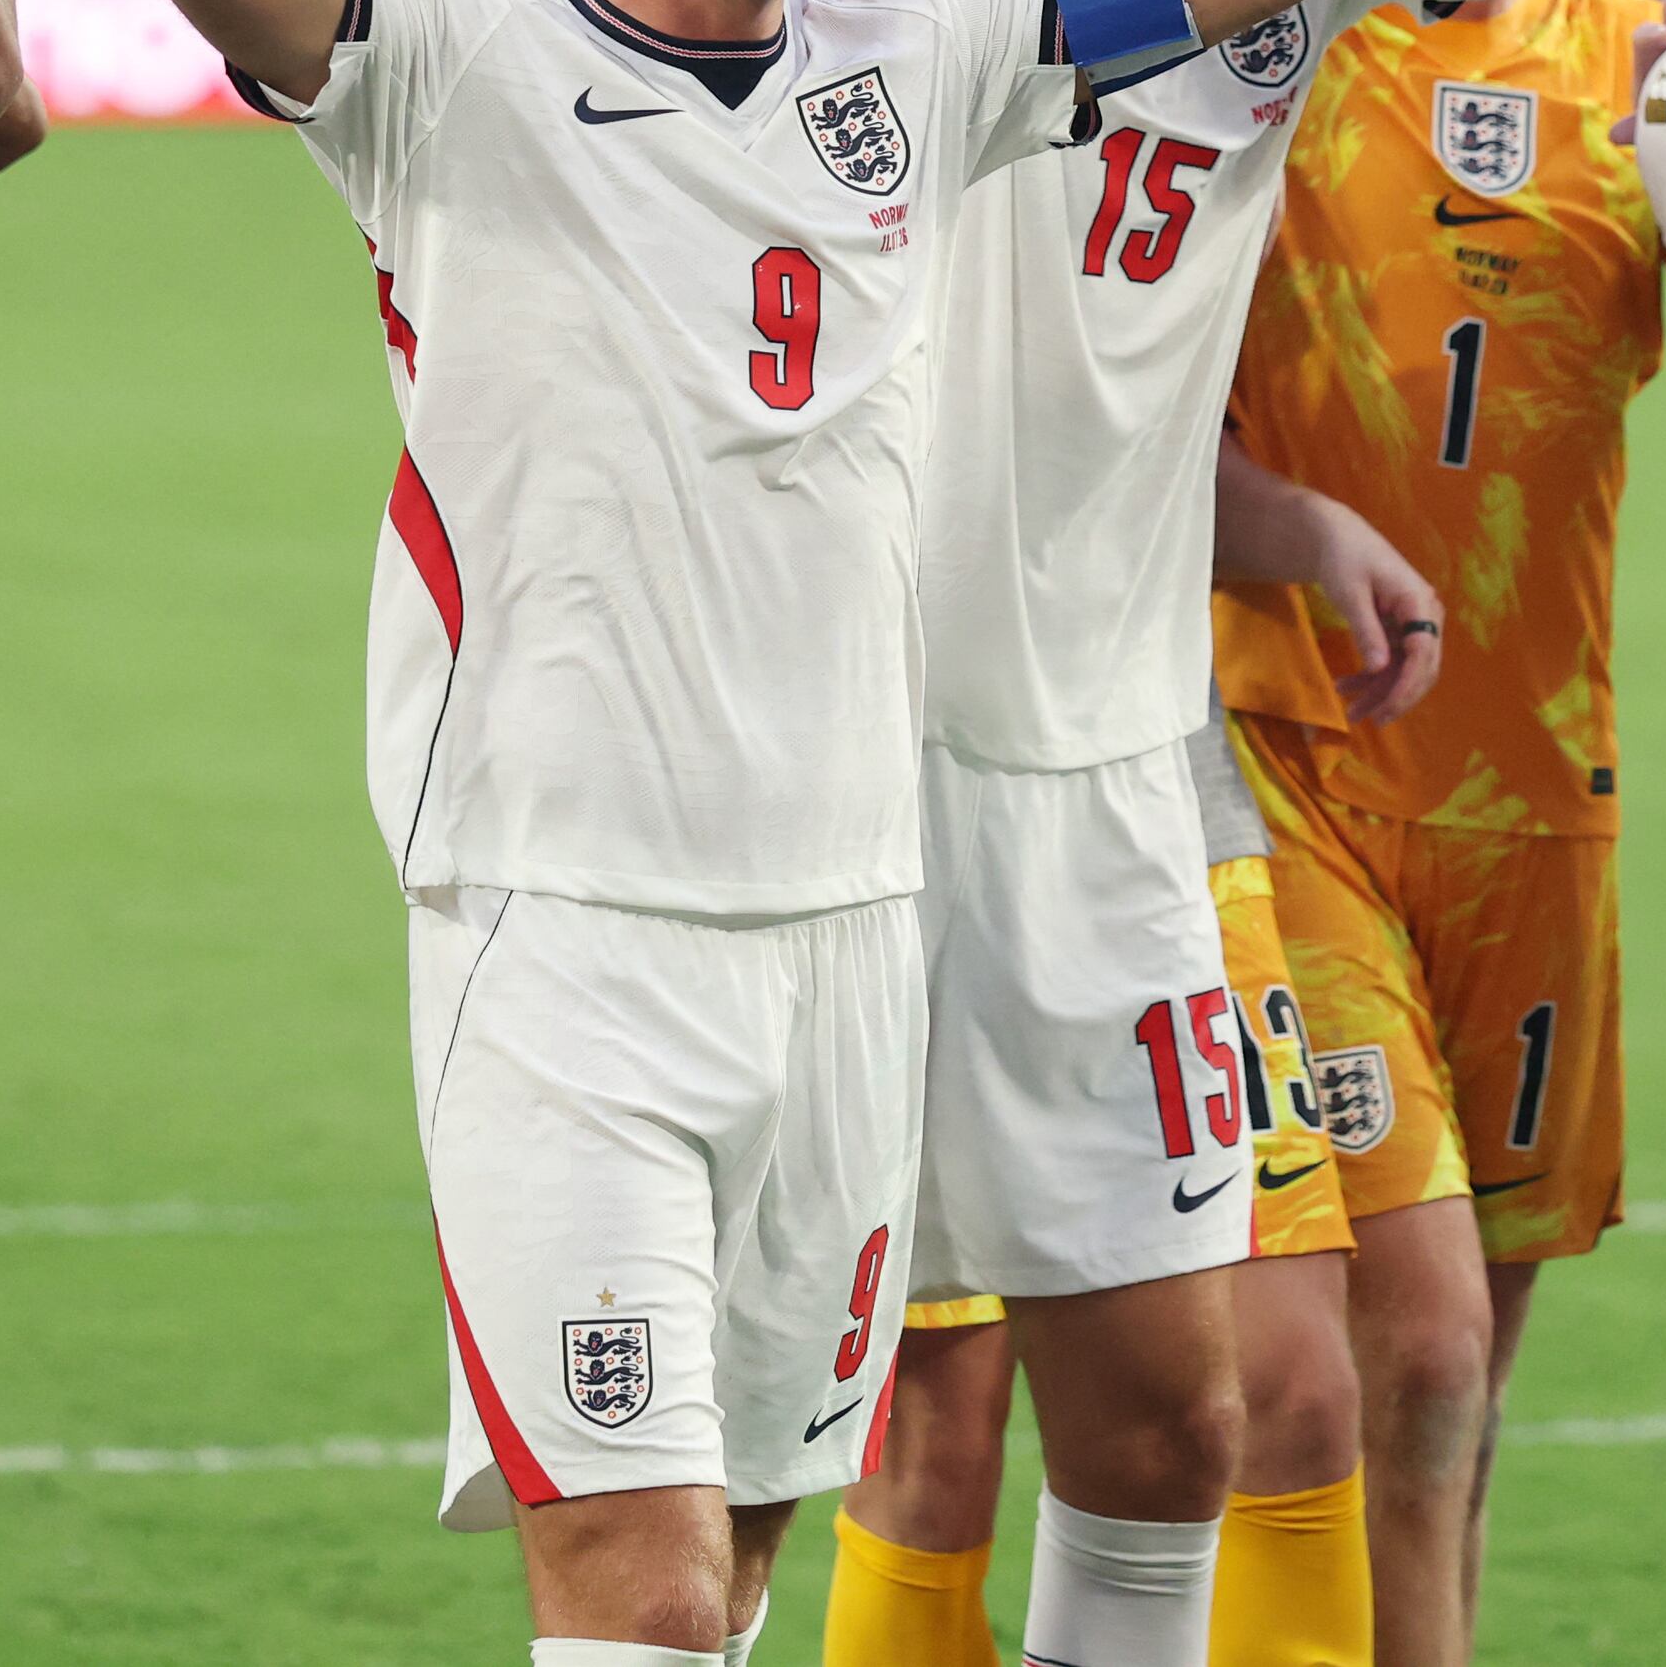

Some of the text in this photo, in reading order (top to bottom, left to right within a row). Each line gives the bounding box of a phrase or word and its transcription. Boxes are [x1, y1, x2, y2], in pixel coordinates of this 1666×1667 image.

[868, 202, 909, 229] NORW
[1082, 127, 1219, 283] 15
[748, 246, 822, 411] 9
[1438, 317, 1485, 470] 1
[1136, 987, 1242, 1159] 15
[1507, 1000, 1556, 1151] 1
[834, 1222, 890, 1384] 9
